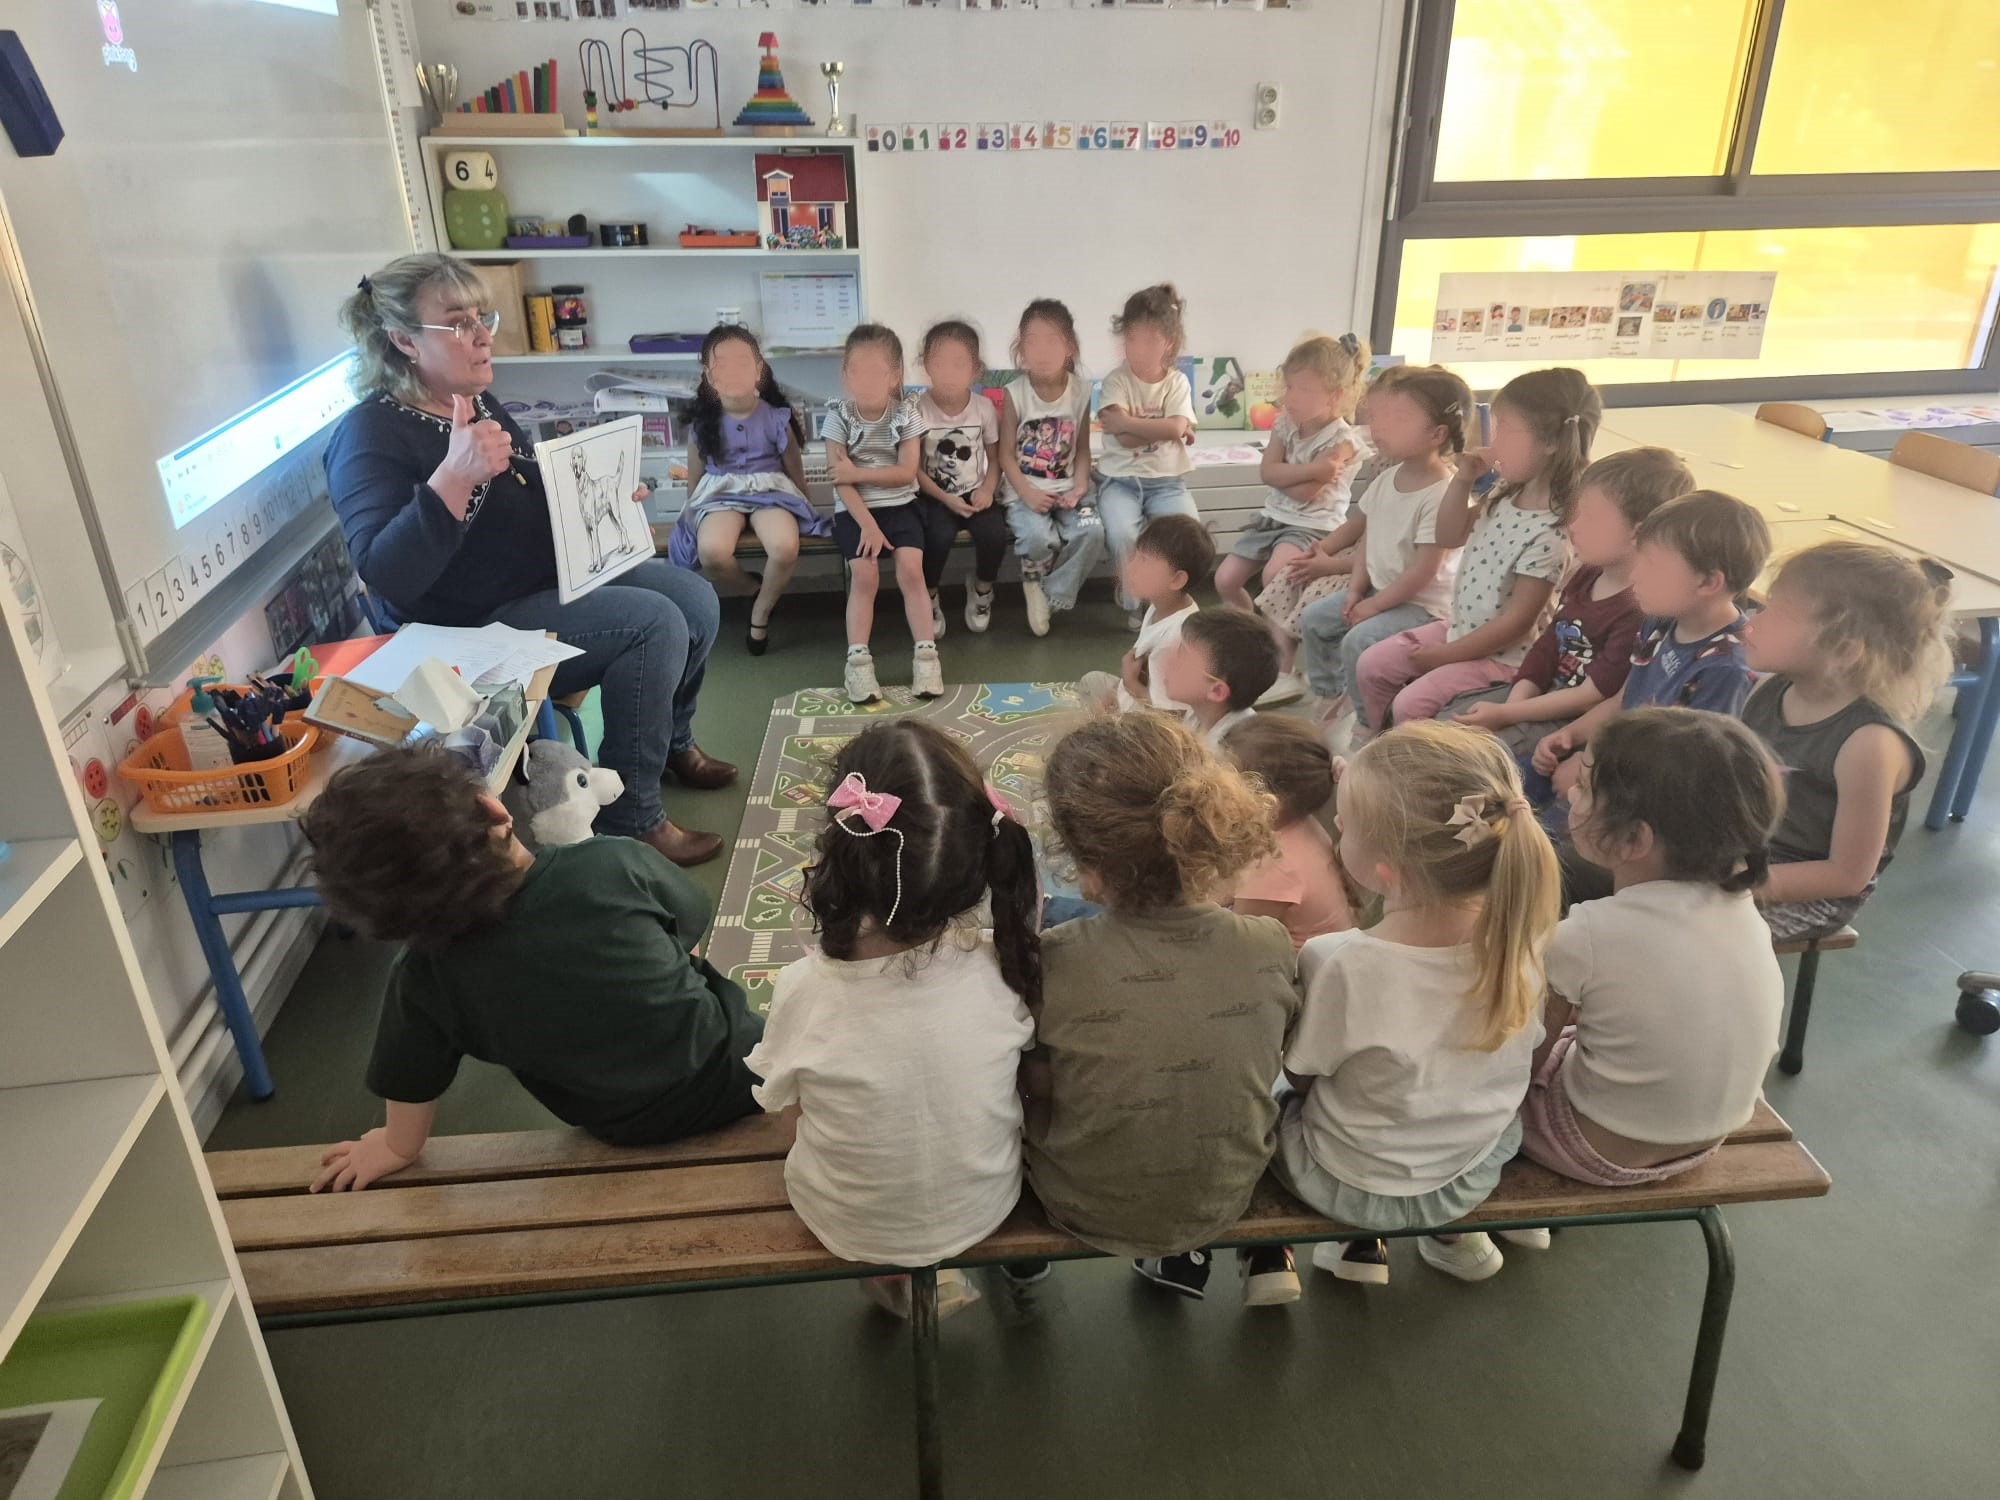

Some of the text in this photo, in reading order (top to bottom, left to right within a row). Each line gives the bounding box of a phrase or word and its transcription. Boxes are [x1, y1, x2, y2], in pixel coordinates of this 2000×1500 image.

[882, 125, 1240, 150] 0 1 2 3 4 5 6 7 8 9 10
[455, 160, 470, 181] 6
[485, 159, 494, 182] 4
[137, 602, 147, 627] 1
[155, 592, 168, 618] 2
[173, 578, 185, 602] 3
[190, 565, 200, 588] 4
[201, 554, 212, 579] 5
[215, 543, 225, 566] 6
[226, 531, 236, 555] 7
[240, 523, 250, 545] 8
[252, 513, 262, 535] 9
[263, 501, 276, 526] 10
